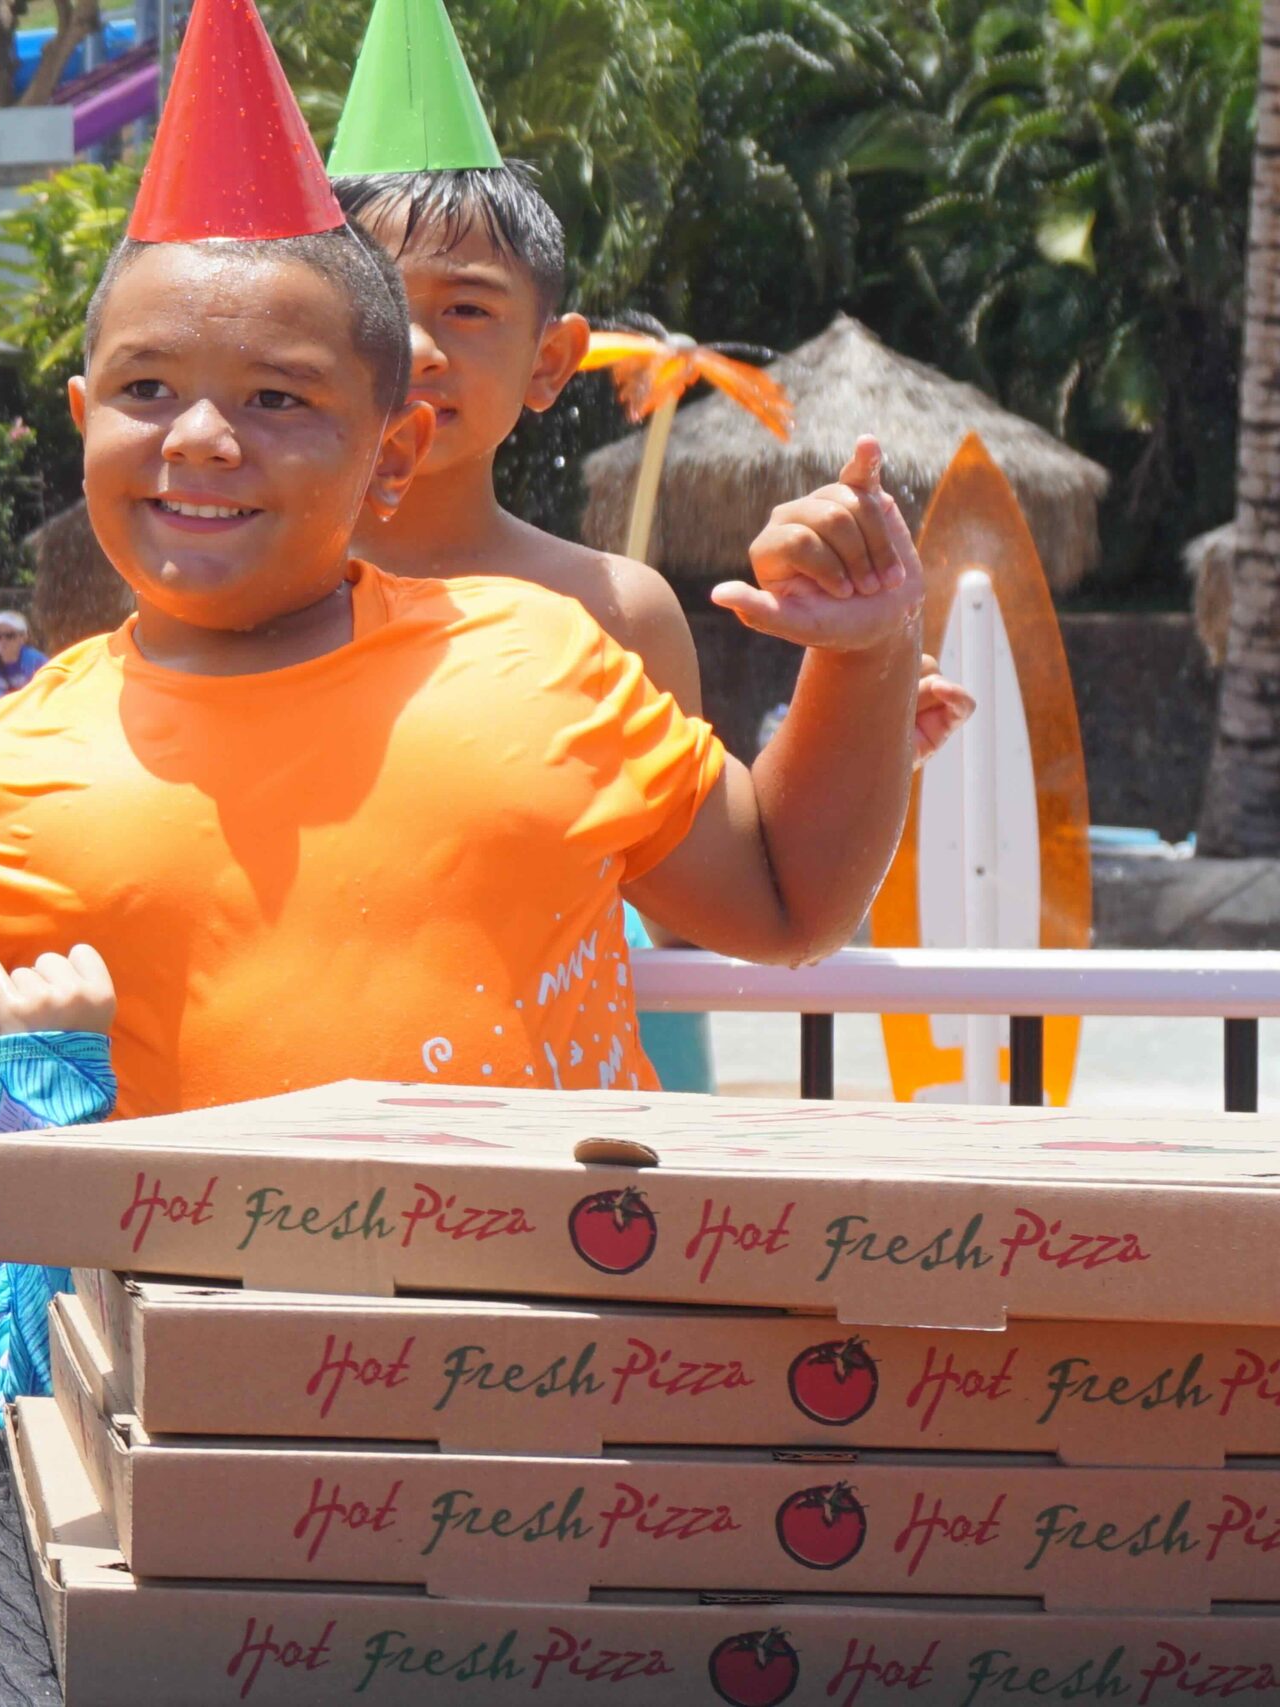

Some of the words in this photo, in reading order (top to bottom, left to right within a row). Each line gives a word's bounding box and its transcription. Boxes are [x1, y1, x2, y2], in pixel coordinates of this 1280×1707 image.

[120, 1172, 218, 1252] Hot
[237, 1187, 395, 1250] Fresh
[401, 1182, 536, 1247] Pizza
[685, 1199, 796, 1284] Hot
[816, 1213, 993, 1281] Fresh
[999, 1208, 1151, 1276] Pizza
[306, 1334, 416, 1418] Hot
[433, 1343, 605, 1411] Fresh
[611, 1338, 755, 1404] Pizza
[906, 1347, 1019, 1431] Hot
[1036, 1353, 1213, 1424] Fresh
[1219, 1348, 1280, 1416] Pi
[294, 1478, 404, 1562] Hot
[421, 1487, 593, 1555] Fresh
[598, 1482, 742, 1548] Pizza
[894, 1493, 1007, 1577] Hot
[1024, 1500, 1200, 1571] Fresh
[227, 1617, 337, 1700] Hot
[354, 1629, 524, 1693] Fresh
[531, 1626, 675, 1689] Pizza
[826, 1638, 941, 1707] Hot
[963, 1645, 1132, 1707] Fresh
[1136, 1641, 1280, 1705] Pizza
